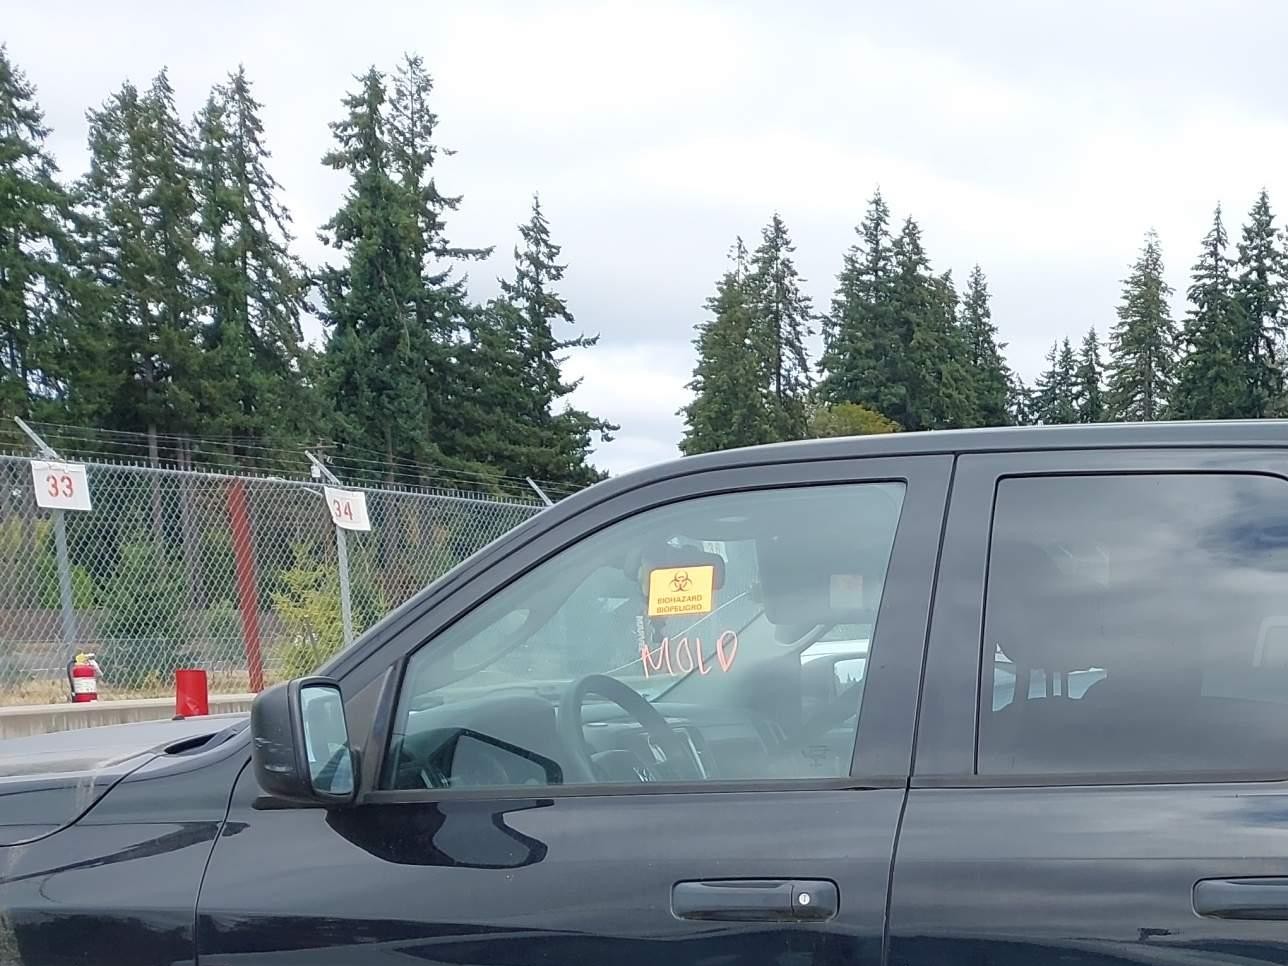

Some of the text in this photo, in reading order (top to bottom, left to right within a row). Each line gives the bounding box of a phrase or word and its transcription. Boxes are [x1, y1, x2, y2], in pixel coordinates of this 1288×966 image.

[46, 475, 74, 498] 33
[333, 499, 353, 520] 34
[656, 603, 703, 613] BIOPELIGRO
[657, 595, 703, 604] BIOHAZARD
[642, 630, 738, 679] MOLD
